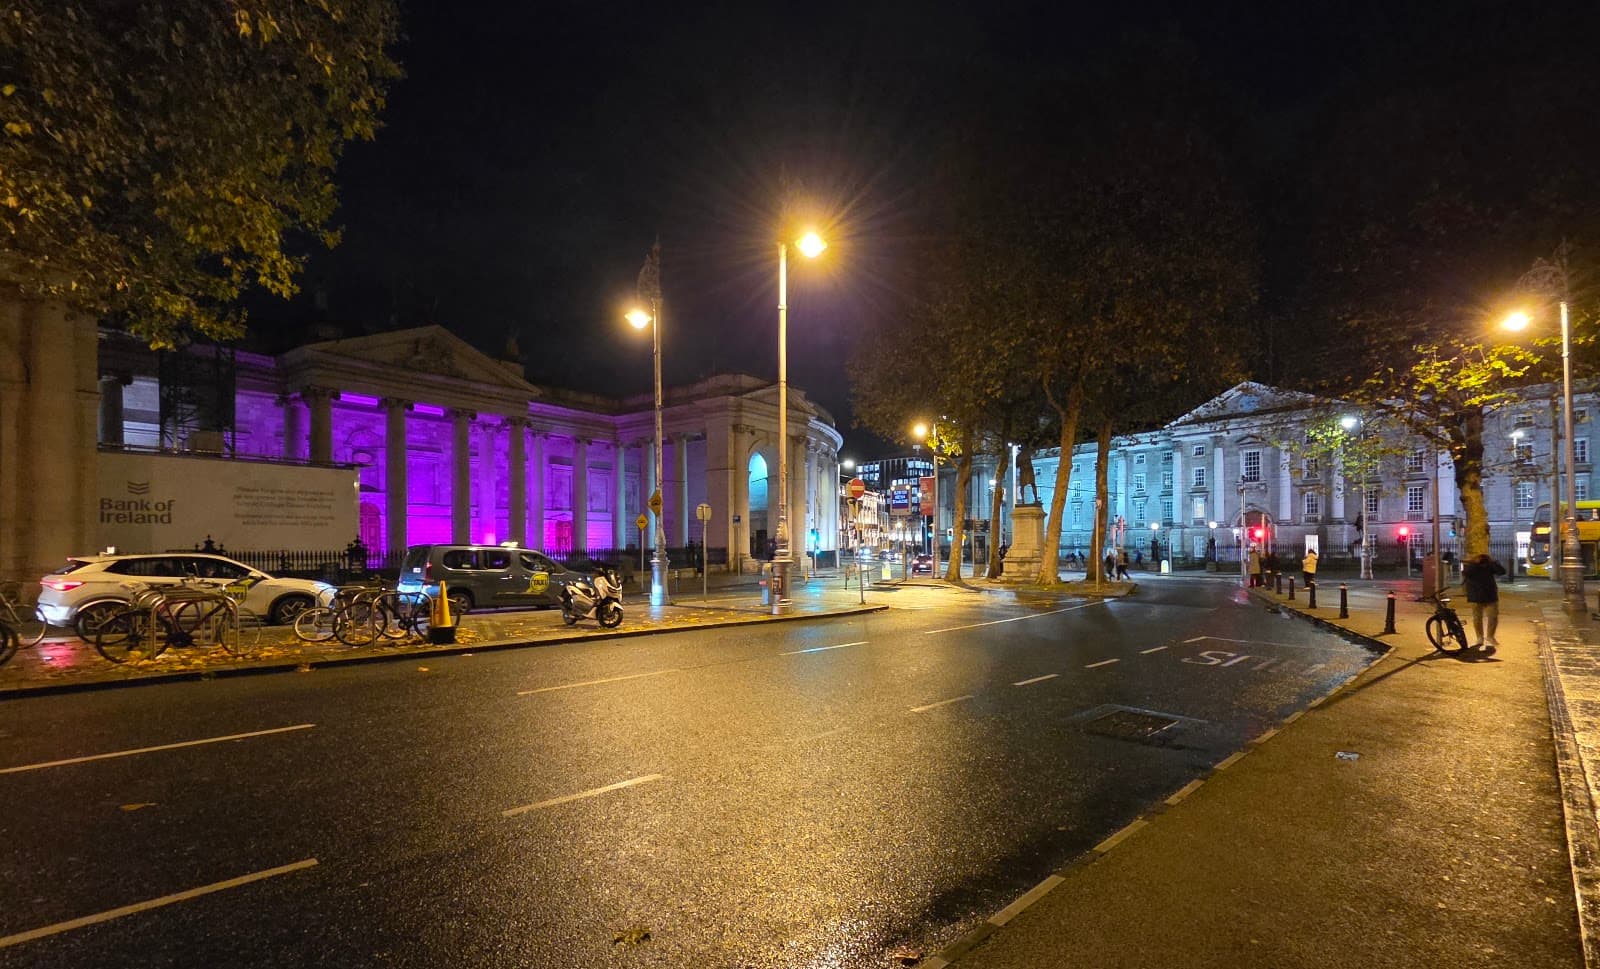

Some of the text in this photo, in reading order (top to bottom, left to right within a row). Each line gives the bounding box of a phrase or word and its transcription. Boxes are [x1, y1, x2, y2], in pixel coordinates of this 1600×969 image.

[100, 498, 176, 512] Bank of
[100, 511, 172, 524] Ireland
[533, 579, 547, 587] TAXI
